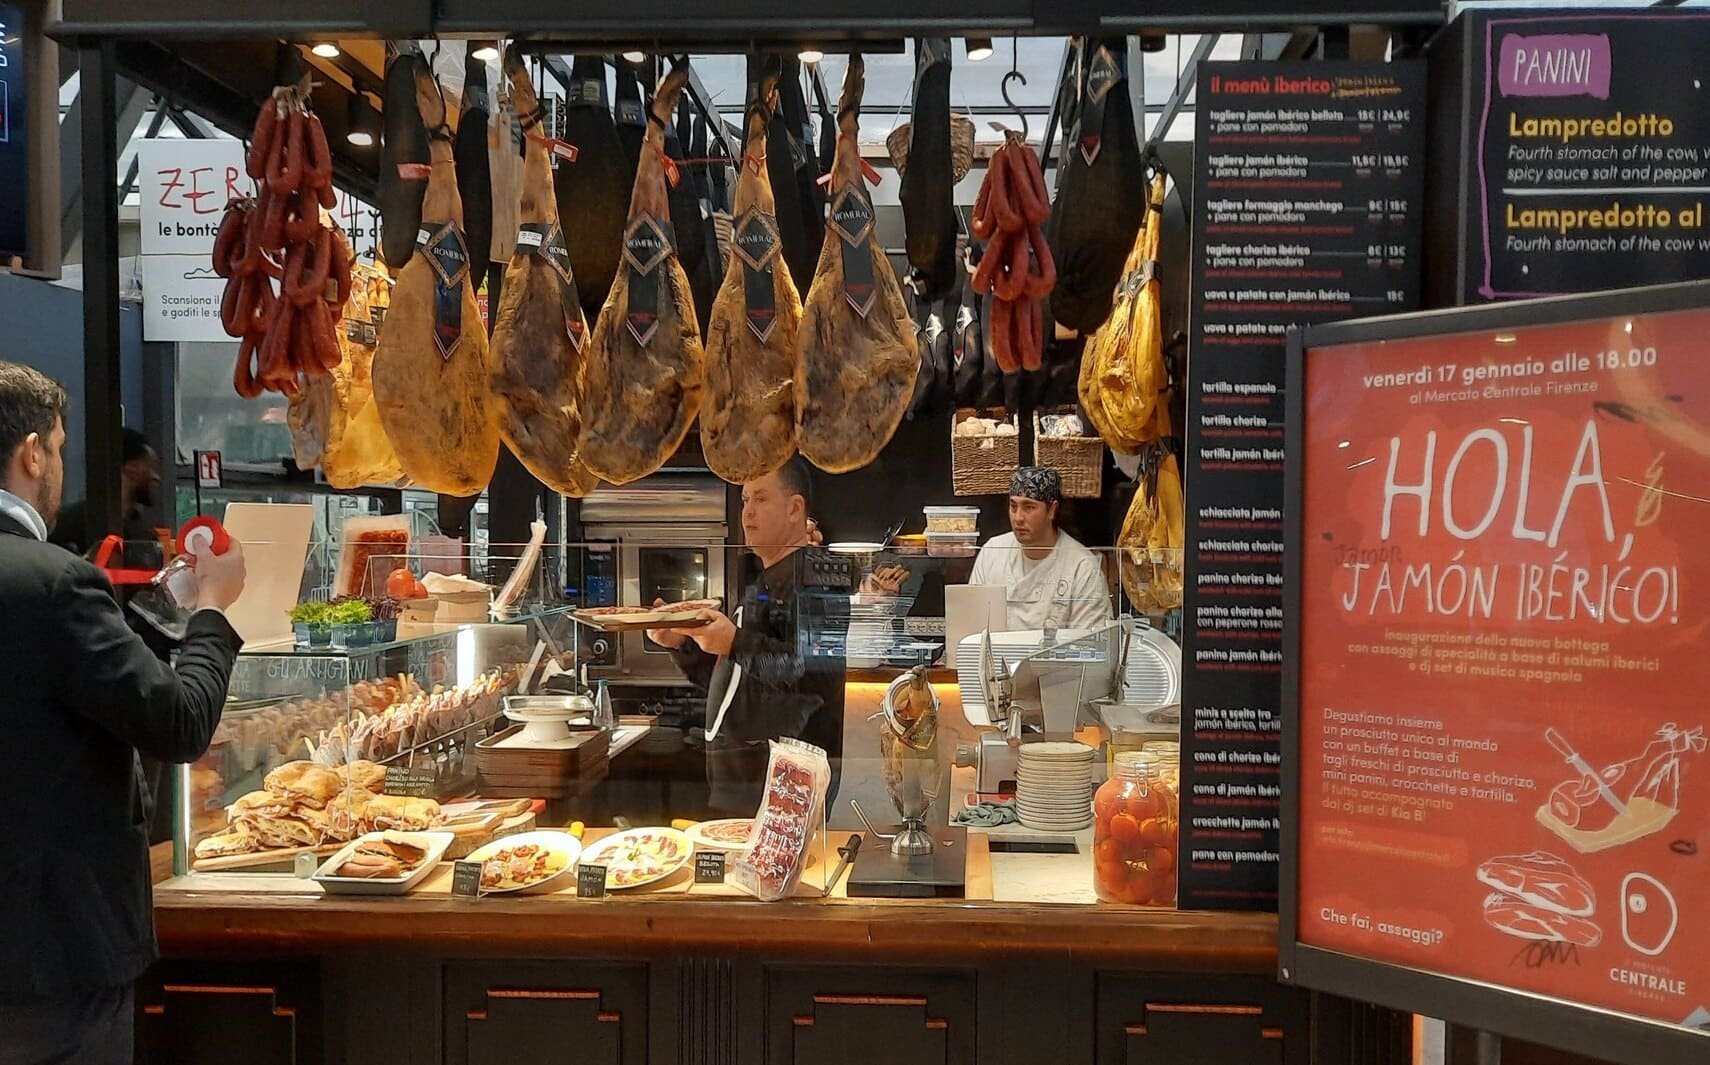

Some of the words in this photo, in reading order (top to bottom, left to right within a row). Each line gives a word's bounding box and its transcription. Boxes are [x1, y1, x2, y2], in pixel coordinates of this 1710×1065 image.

[1513, 48, 1592, 85] PANINI
[1224, 75, 1270, 93] menù
[1209, 110, 1244, 122] tagliere
[1247, 109, 1276, 122] jamón
[1311, 110, 1344, 121] bellota
[1217, 123, 1239, 133] pane
[1242, 124, 1259, 132] con
[1261, 123, 1309, 133] pomodoro
[1509, 111, 1674, 143] Lampredotto
[1208, 155, 1244, 168] tagliere
[1246, 155, 1275, 168] jamón
[1508, 144, 1552, 161] Fourth
[1557, 144, 1617, 161] stomach
[1621, 144, 1638, 161] of
[1639, 144, 1663, 161] the
[1666, 148, 1699, 163] cow,
[1215, 168, 1239, 179] pane
[1241, 169, 1258, 177] con
[1259, 167, 1307, 179] pomodoro
[1507, 164, 1543, 184] spicy
[1546, 167, 1589, 180] sauce
[1592, 165, 1617, 180] salt
[1621, 165, 1651, 180] and
[1653, 167, 1707, 184] pepper
[1207, 200, 1243, 212] tagliere
[1245, 200, 1293, 212] formaggio
[1294, 200, 1344, 213] manchego
[1506, 201, 1672, 235] Lampredotto
[1678, 201, 1703, 227] al
[158, 221, 172, 236] le
[176, 221, 219, 237] bontà
[1206, 245, 1241, 257] tagliere
[1243, 244, 1277, 256] chorizo
[1506, 234, 1550, 251] Fourth
[1555, 234, 1616, 251] stomach
[1620, 234, 1637, 251] of
[1638, 234, 1661, 251] the
[1664, 239, 1695, 251] cow
[161, 294, 209, 306] Scansiona
[211, 294, 220, 305] il
[1204, 291, 1227, 300] uova
[1229, 292, 1235, 300] e
[1237, 290, 1267, 301] patate
[1269, 291, 1287, 300] con
[1287, 290, 1317, 302] jamón
[161, 309, 169, 317] e
[170, 306, 199, 319] goditi
[201, 307, 211, 317] le
[1363, 366, 1433, 389] venerdì
[1438, 364, 1457, 382] 17
[1463, 356, 1545, 386] gennaio
[1551, 352, 1591, 374] alle
[1597, 346, 1658, 370] 18.00
[1202, 382, 1233, 393] tortilla
[1409, 392, 1423, 405] al
[1425, 387, 1480, 403] Mercato
[1483, 382, 1542, 400] Centrale
[1546, 379, 1599, 394] Firenze
[1201, 414, 1232, 426] tortilla
[1233, 415, 1267, 426] chorizo
[1199, 506, 1250, 518] schiacciata
[1251, 507, 1280, 521] jamón
[1343, 549, 1499, 618] JAMÓN
[1516, 550, 1679, 624] IBÉRICO!
[1197, 604, 1229, 617] panino
[1230, 605, 1264, 617] chorizo
[1265, 606, 1283, 618] alla
[1197, 618, 1214, 628] con
[1215, 618, 1258, 630] peperone
[1260, 619, 1283, 629] rosso
[1384, 628, 1472, 645] inaugurazione
[1475, 632, 1507, 646] della
[1510, 638, 1551, 649] nuova
[1554, 636, 1610, 654] bottega
[1348, 643, 1370, 653] con
[1371, 643, 1418, 659] assaggi
[1420, 644, 1433, 657] di
[1435, 645, 1497, 663] specialità
[1500, 652, 1509, 661] a
[1512, 649, 1544, 664] base
[1547, 652, 1561, 665] di
[1563, 653, 1610, 668] salumi
[1613, 656, 1659, 672] iberici
[1408, 662, 1417, 671] e
[1419, 660, 1432, 675] dj
[1434, 662, 1452, 673] set
[1455, 662, 1467, 675] di
[1470, 664, 1516, 678] musica
[1519, 666, 1583, 684] spagnola
[1228, 707, 1256, 720] scelta
[1257, 708, 1271, 720] tra
[1323, 707, 1394, 727] Degustiamo
[1396, 713, 1444, 730] insieme
[1194, 718, 1223, 731] jamón
[1323, 725, 1338, 735] un
[1340, 726, 1399, 742] prosciutto
[1401, 731, 1434, 745] unico
[1437, 735, 1450, 746] al
[1453, 736, 1498, 752] mondo
[1322, 739, 1343, 750] con
[1346, 742, 1361, 752] un
[1363, 740, 1400, 757] buffet
[1402, 748, 1410, 758] a
[1413, 747, 1444, 762] base
[1446, 750, 1460, 764] di
[1322, 753, 1348, 768] tagli
[1350, 754, 1390, 771] freschi
[1393, 760, 1405, 772] di
[1407, 762, 1470, 781] prosciutto
[1473, 773, 1481, 782] e
[1484, 770, 1537, 791] chorizo,
[1322, 768, 1347, 781] mini
[1349, 771, 1389, 788] panini,
[1391, 777, 1457, 795] crocchette
[1459, 787, 1468, 795] e
[1332, 784, 1359, 797] tutto
[1361, 789, 1453, 810] accompagnato
[1322, 798, 1340, 809] dal
[1343, 800, 1354, 814] dj
[1357, 803, 1375, 814] set
[1377, 804, 1388, 817] di
[1391, 804, 1411, 820] Kia
[1320, 906, 1347, 926] Che
[1351, 911, 1374, 932] fai,
[1377, 921, 1444, 946] assaggi?
[1609, 967, 1687, 997] CENTRALE
